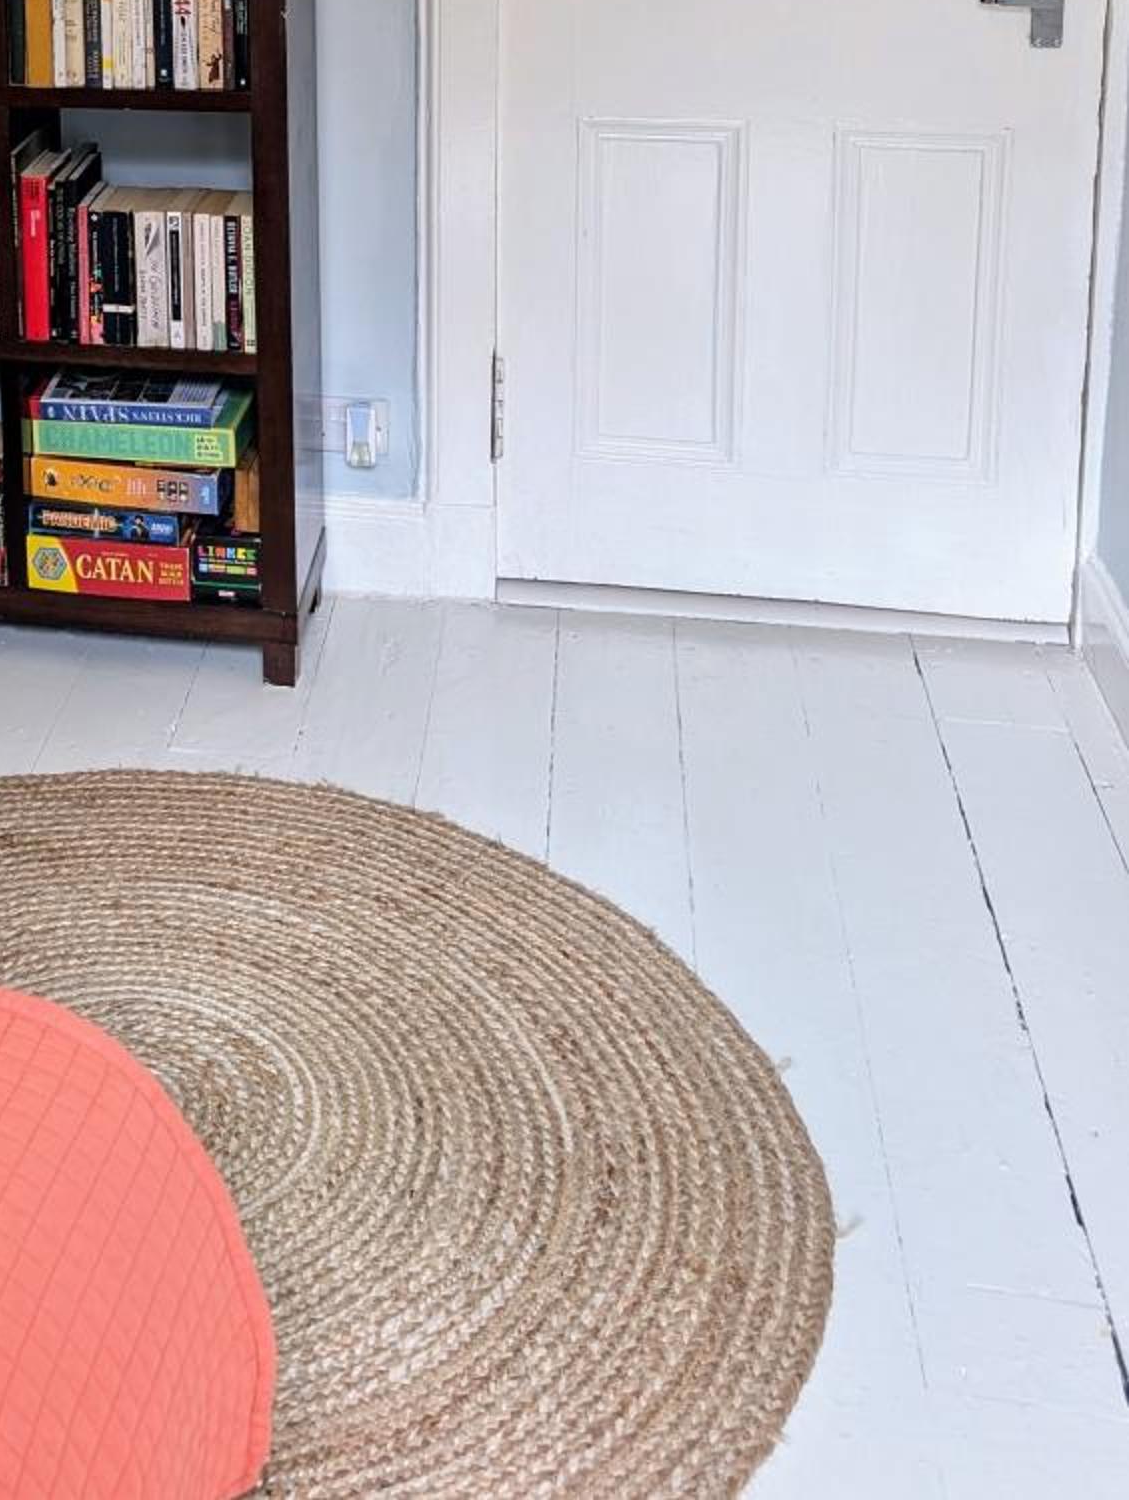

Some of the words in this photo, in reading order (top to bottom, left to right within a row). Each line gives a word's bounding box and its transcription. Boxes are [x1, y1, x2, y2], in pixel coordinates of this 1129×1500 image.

[63, 405, 129, 420] SPAIN
[44, 427, 188, 457] CHAMELEON
[76, 554, 154, 584] CATAN
